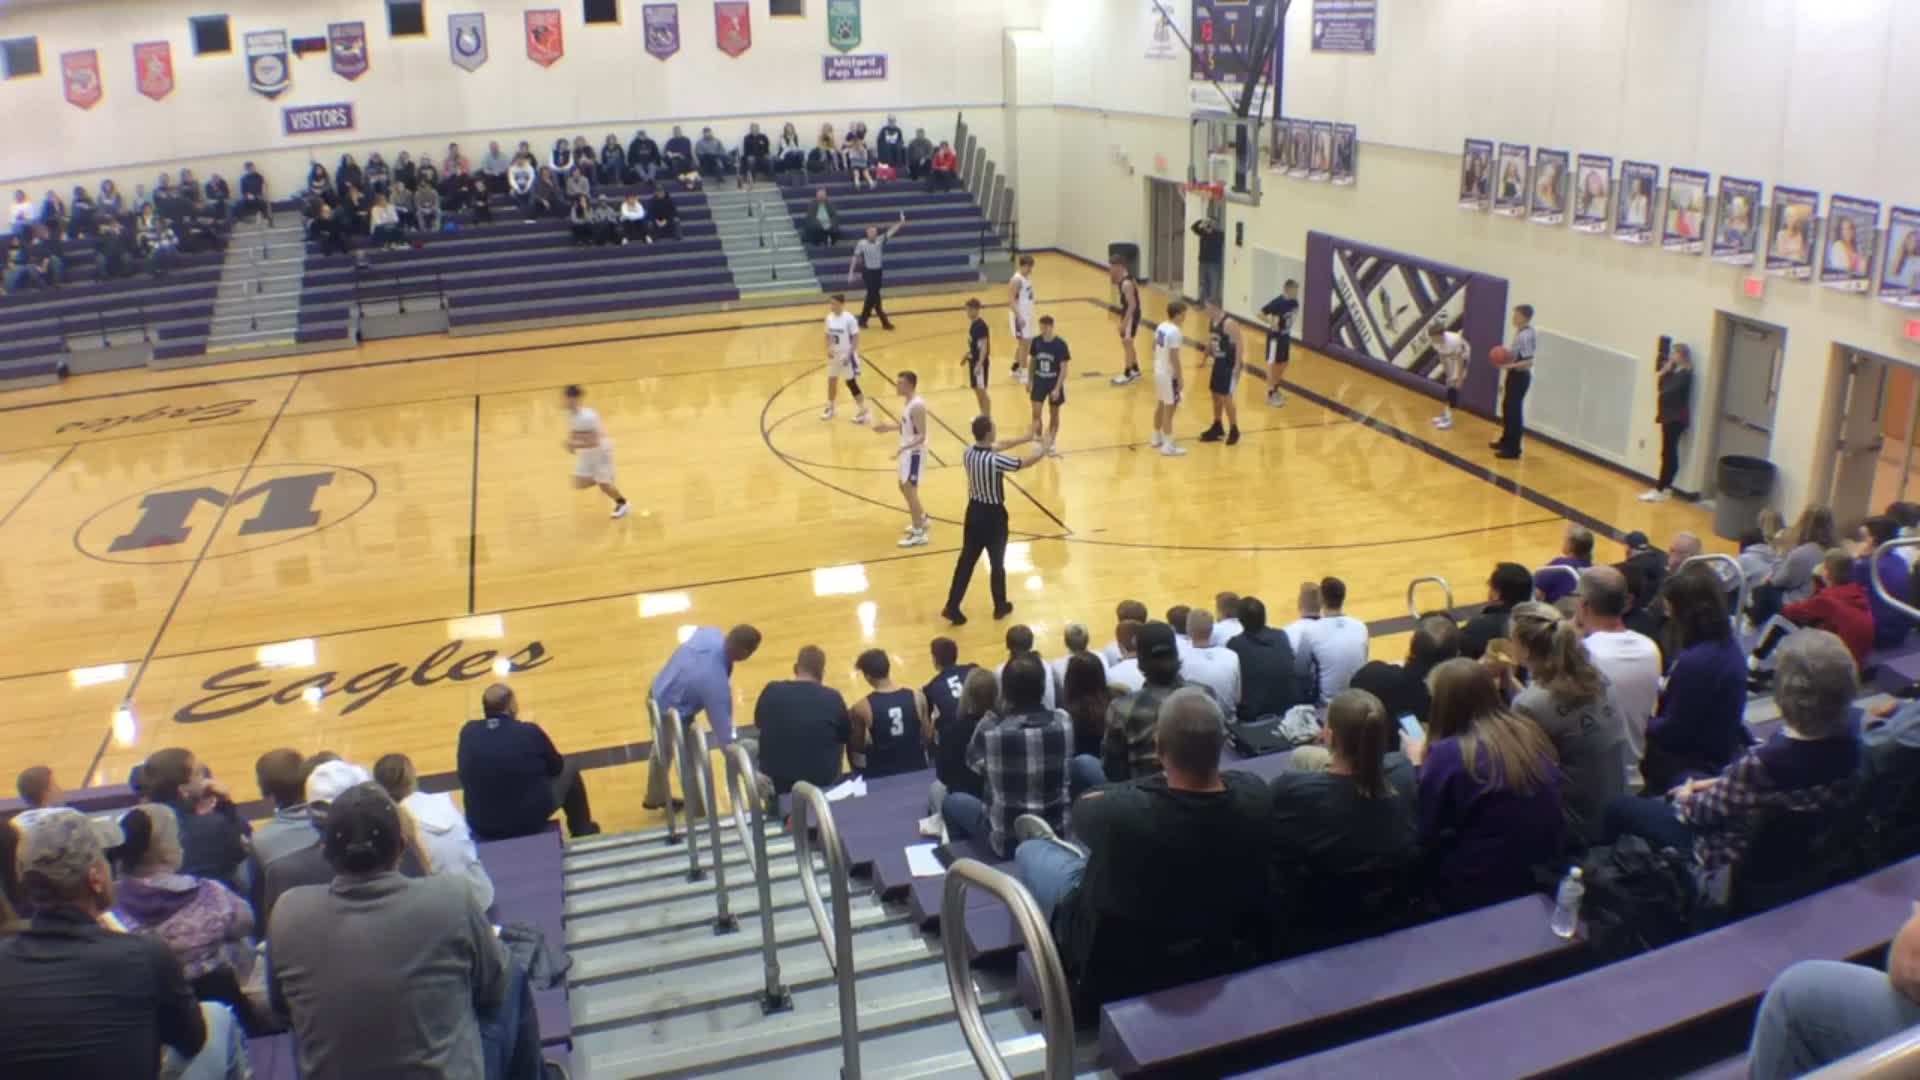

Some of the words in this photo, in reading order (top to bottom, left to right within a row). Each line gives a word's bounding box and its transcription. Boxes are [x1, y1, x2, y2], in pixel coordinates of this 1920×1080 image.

[828, 68, 850, 79] Pep
[853, 67, 883, 78] Band
[832, 56, 876, 68] Milford
[290, 108, 348, 129] VISITORS
[107, 471, 336, 552] M
[173, 639, 554, 723] Eagles
[947, 674, 964, 698] 5
[888, 706, 904, 736] 3
